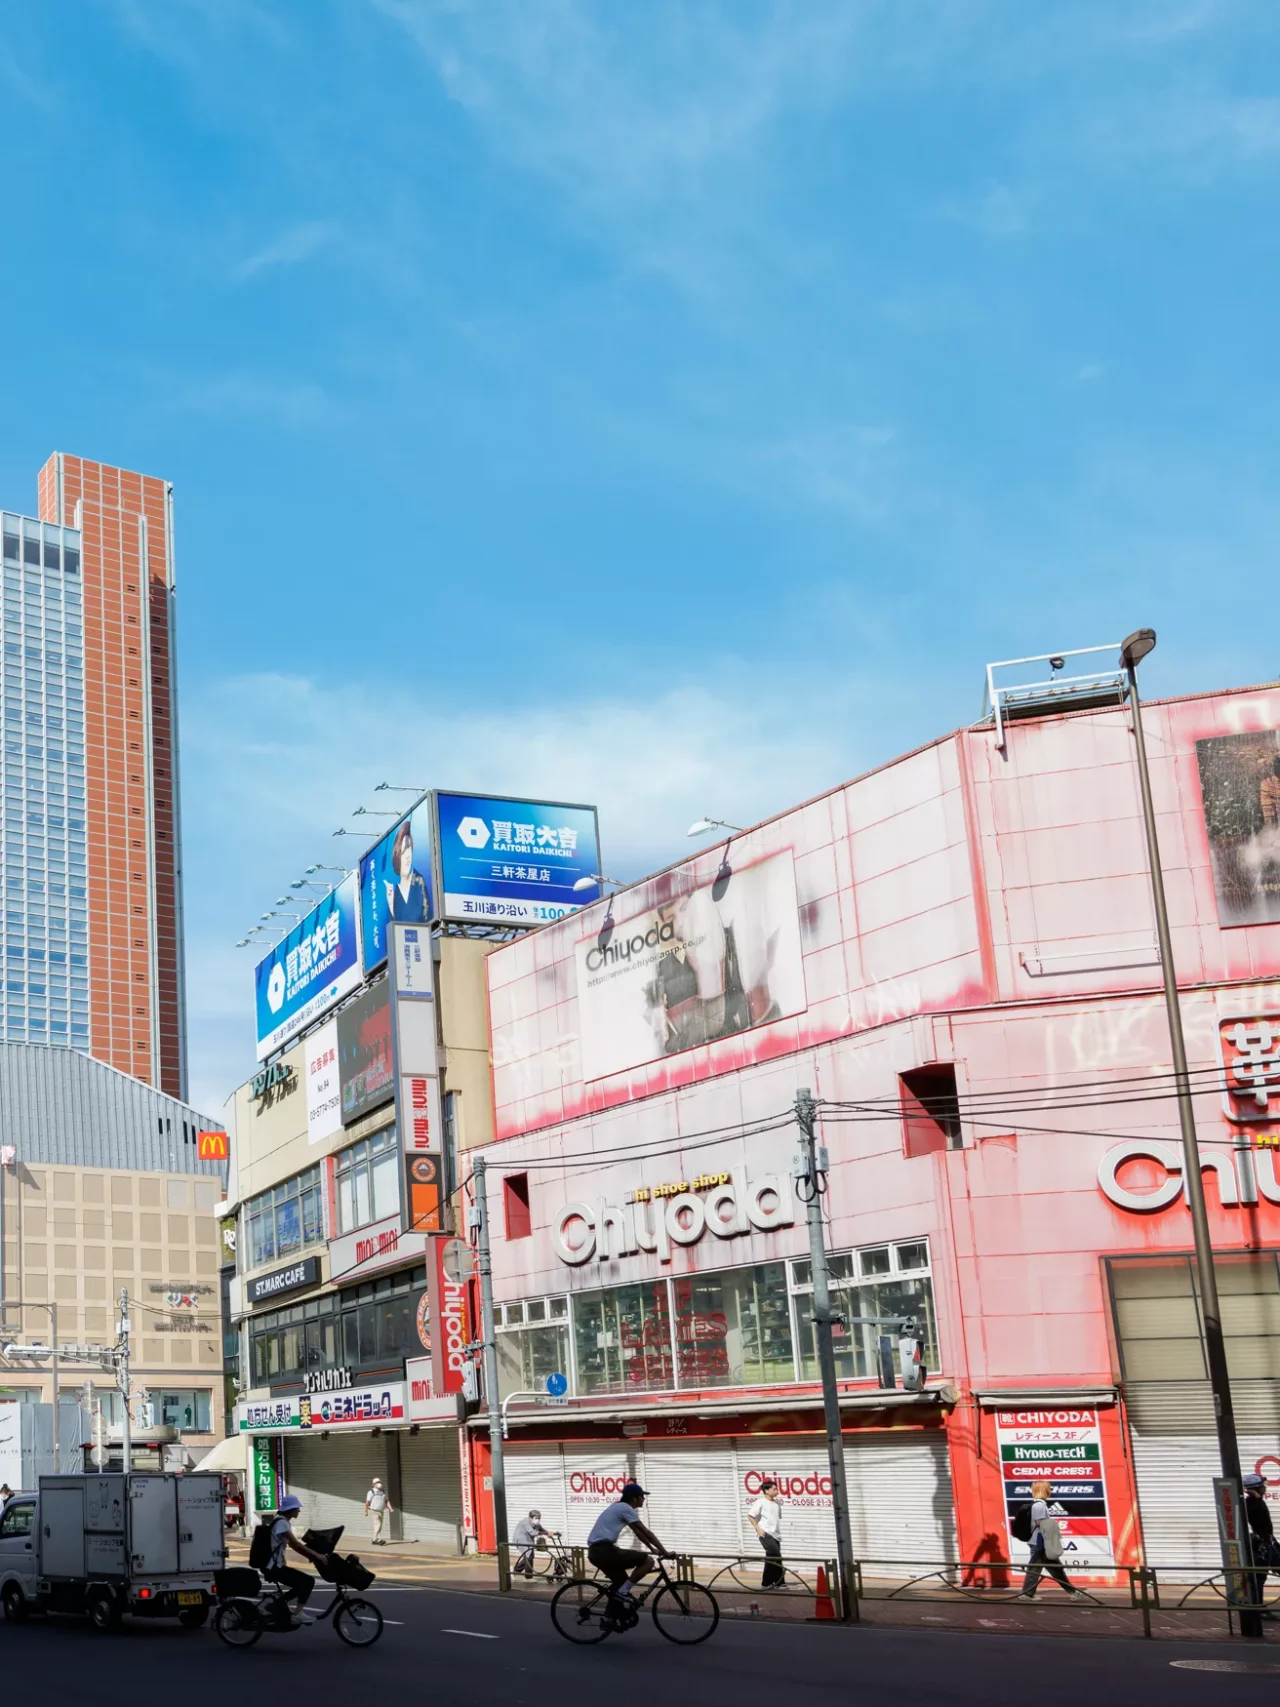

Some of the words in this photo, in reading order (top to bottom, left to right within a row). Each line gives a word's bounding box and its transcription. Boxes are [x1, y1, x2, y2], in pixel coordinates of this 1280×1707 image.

[492, 820, 578, 849] 買取大吉
[493, 843, 530, 853] KAITORI
[533, 847, 572, 857] DAIKICHI
[491, 866, 551, 881] 三軒茶屋店
[463, 901, 528, 916] 玉川通り沿い
[285, 909, 340, 988] 買取大吉
[586, 921, 675, 972] Chiyoda
[412, 1079, 428, 1108] mini
[414, 1118, 430, 1148] mini
[634, 1188, 649, 1203] hi
[652, 1182, 690, 1198] shoe
[692, 1172, 729, 1190] shop
[553, 1165, 795, 1267] Chiyoda
[255, 1275, 285, 1295] ST.MARC
[441, 1266, 465, 1371] hiyoda
[303, 1366, 353, 1392] サンマルクカフェ
[247, 1404, 292, 1428] 処方せん受付
[300, 1400, 311, 1426] 薬
[335, 1391, 392, 1418] ミネドラッグ
[1017, 1411, 1093, 1424] CHIYODA
[1015, 1432, 1061, 1440] レディース
[1064, 1431, 1077, 1439] 2F
[1014, 1446, 1086, 1459] HYDRO-TECH
[258, 1438, 271, 1508] 処方せん受付
[1012, 1467, 1052, 1476] CEDAR
